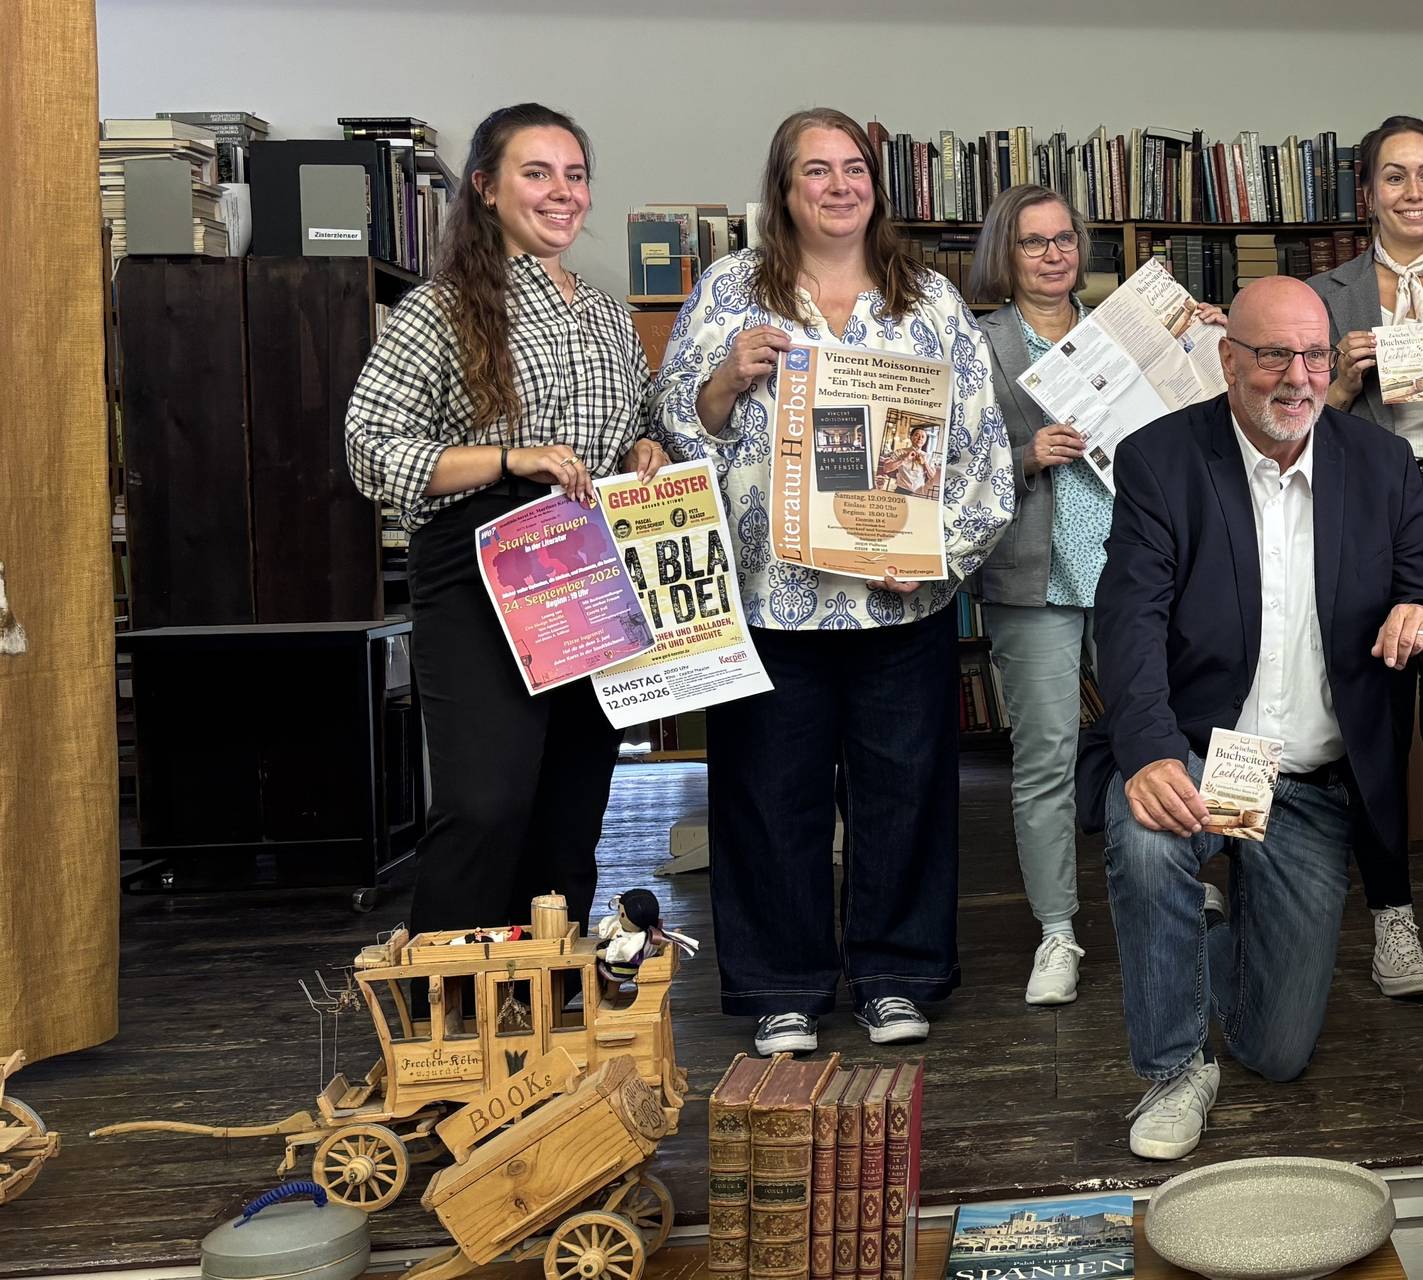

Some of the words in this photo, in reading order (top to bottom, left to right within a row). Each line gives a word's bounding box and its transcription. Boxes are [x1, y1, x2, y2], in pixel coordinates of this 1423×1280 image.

[314, 231, 359, 239] Zisterzienser
[824, 352, 868, 367] Vincent
[871, 357, 942, 376] Moissonnier
[833, 367, 862, 377] erzählt
[878, 373, 908, 382] seinem
[909, 376, 931, 385] Buch
[850, 378, 877, 389] Tisch
[818, 388, 870, 400] Moderation:
[871, 393, 902, 404] Bettina
[903, 396, 943, 408] Böttinger
[608, 487, 651, 509] GERD
[653, 475, 709, 501] KÖSTER
[885, 503, 897, 511] Uhr
[481, 526, 497, 540] Wo?
[498, 530, 541, 553] Starke
[543, 515, 588, 537] Frauen
[656, 529, 729, 586] BLA
[502, 601, 523, 615] 24.
[525, 579, 586, 606] September
[587, 565, 621, 586] 2026
[571, 591, 578, 600] 19
[578, 587, 589, 598] Uhr
[669, 574, 731, 625] DEI
[675, 627, 692, 637] UND
[693, 617, 735, 633] BALLADEN,
[668, 637, 685, 648] UND
[686, 629, 723, 644] GEDICHTE
[718, 651, 748, 665] Kerpen
[602, 674, 663, 697] SAMSTAG
[606, 687, 671, 711] 12.09.2026
[1215, 747, 1269, 767] Buchseiten
[1229, 743, 1258, 755] Zwischen
[1212, 763, 1266, 785] Lachfalten
[956, 1259, 1130, 1280] SPANIEN
